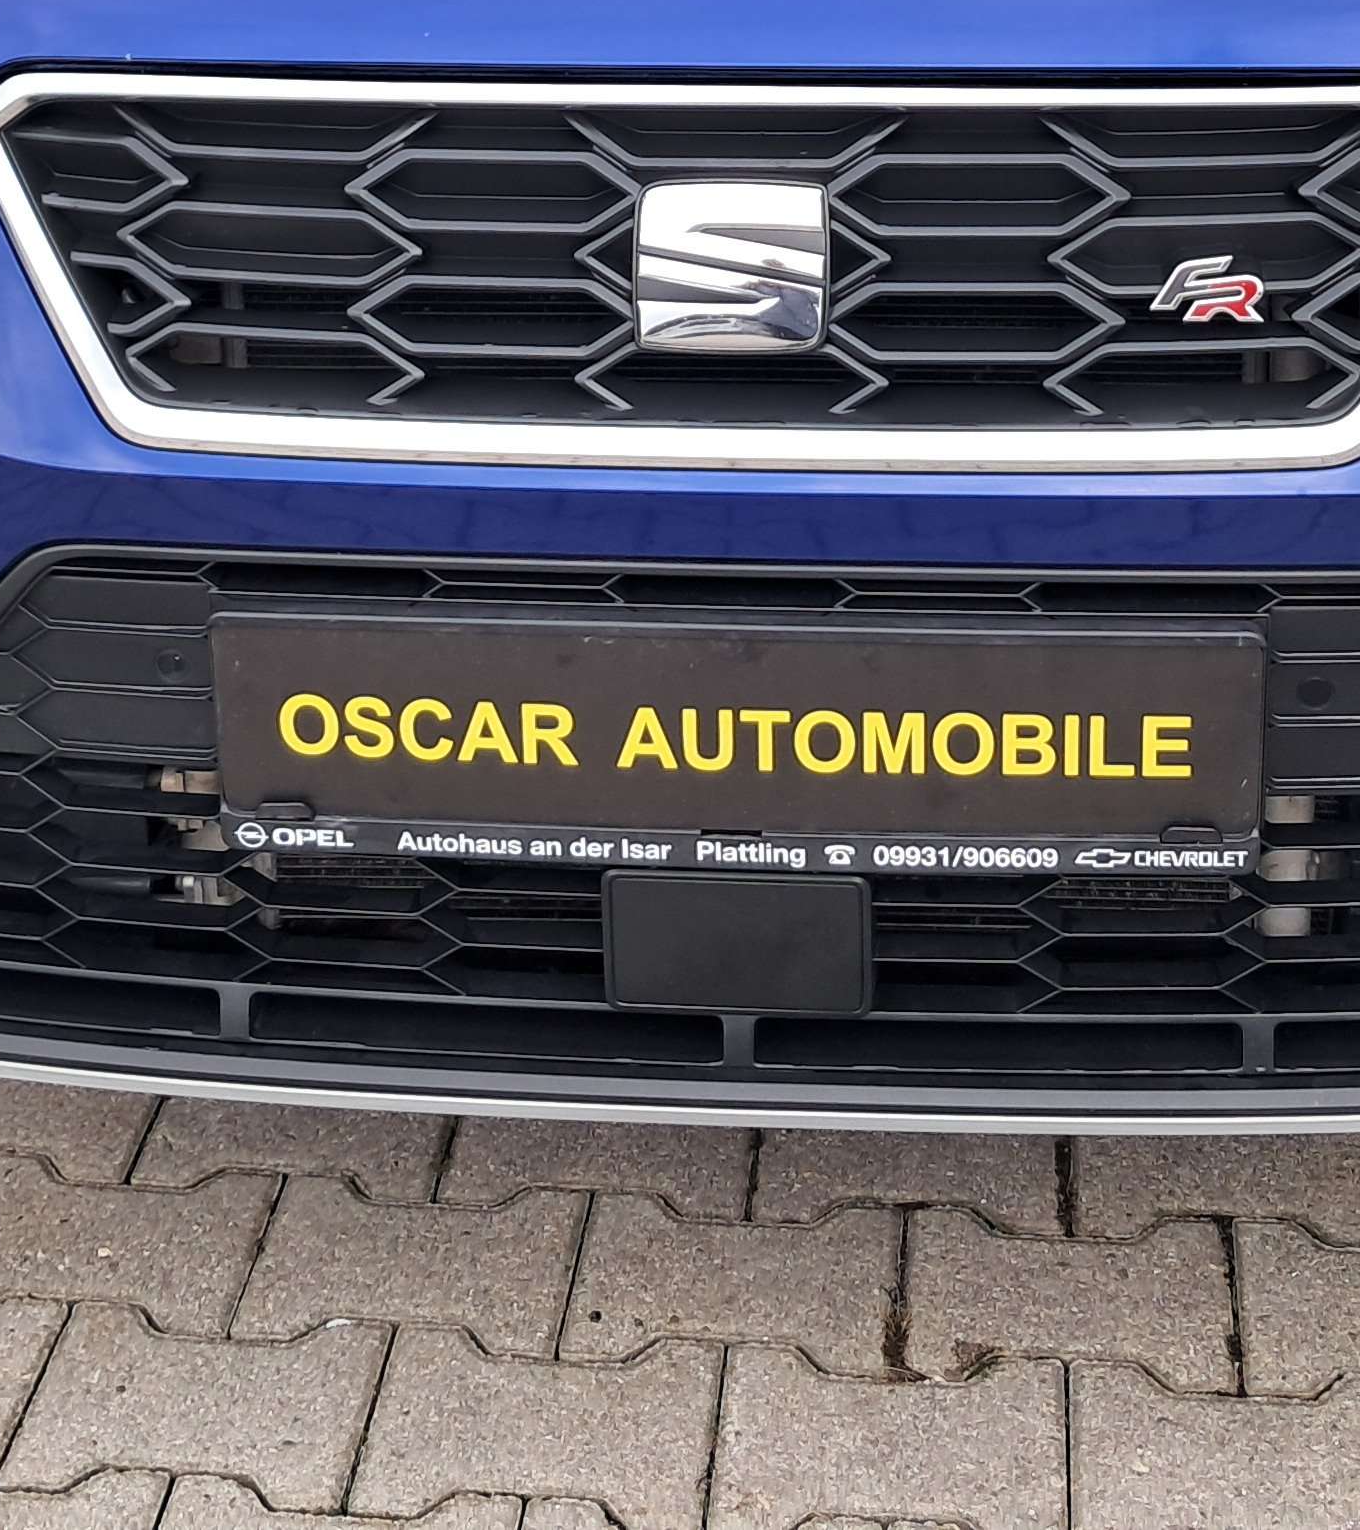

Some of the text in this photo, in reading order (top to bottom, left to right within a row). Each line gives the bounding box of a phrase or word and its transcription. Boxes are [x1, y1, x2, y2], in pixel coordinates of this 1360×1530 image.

[1149, 255, 1265, 323] FR
[278, 694, 1193, 779] OSCAR AUTOMOBILE
[271, 826, 1249, 869] OPEL Autohaus an der Isar Plattling 09931/906609 CHEVROLET
